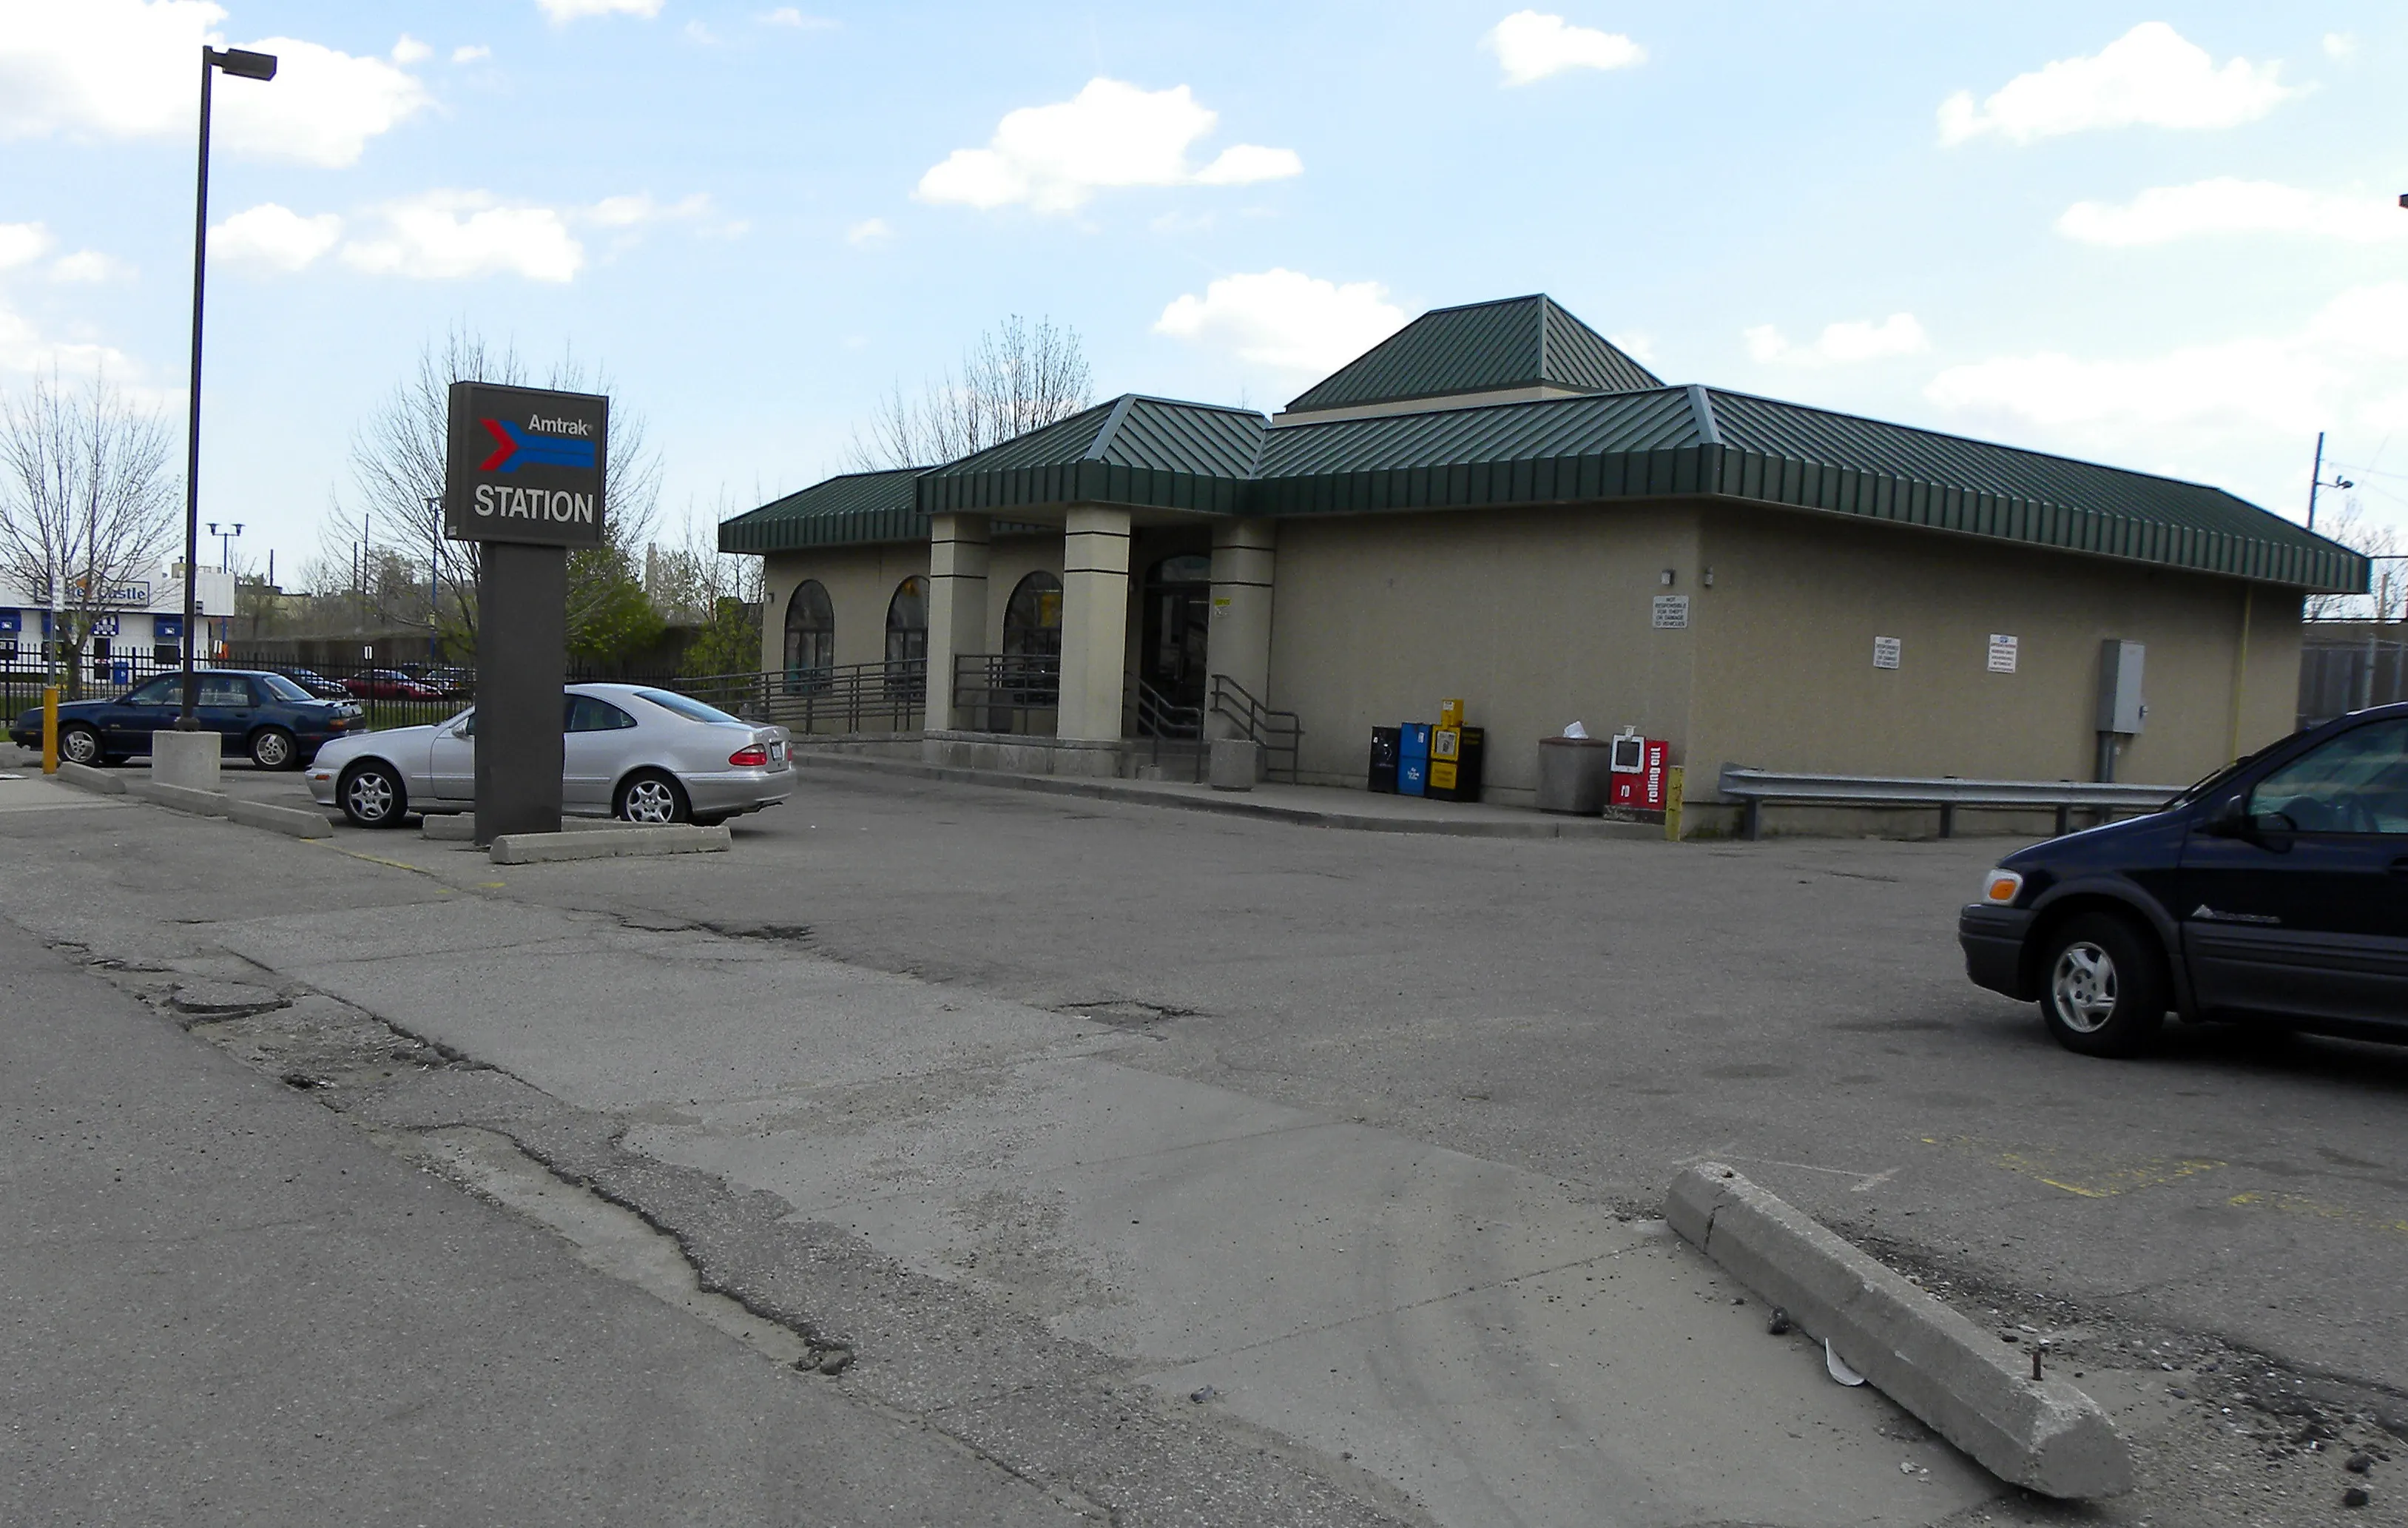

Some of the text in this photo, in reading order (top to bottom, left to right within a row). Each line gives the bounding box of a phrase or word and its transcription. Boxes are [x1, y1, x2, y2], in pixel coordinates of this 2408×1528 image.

[527, 414, 589, 437] Amtrak
[473, 483, 594, 524] STATION
[1648, 747, 1661, 803] rolling out
